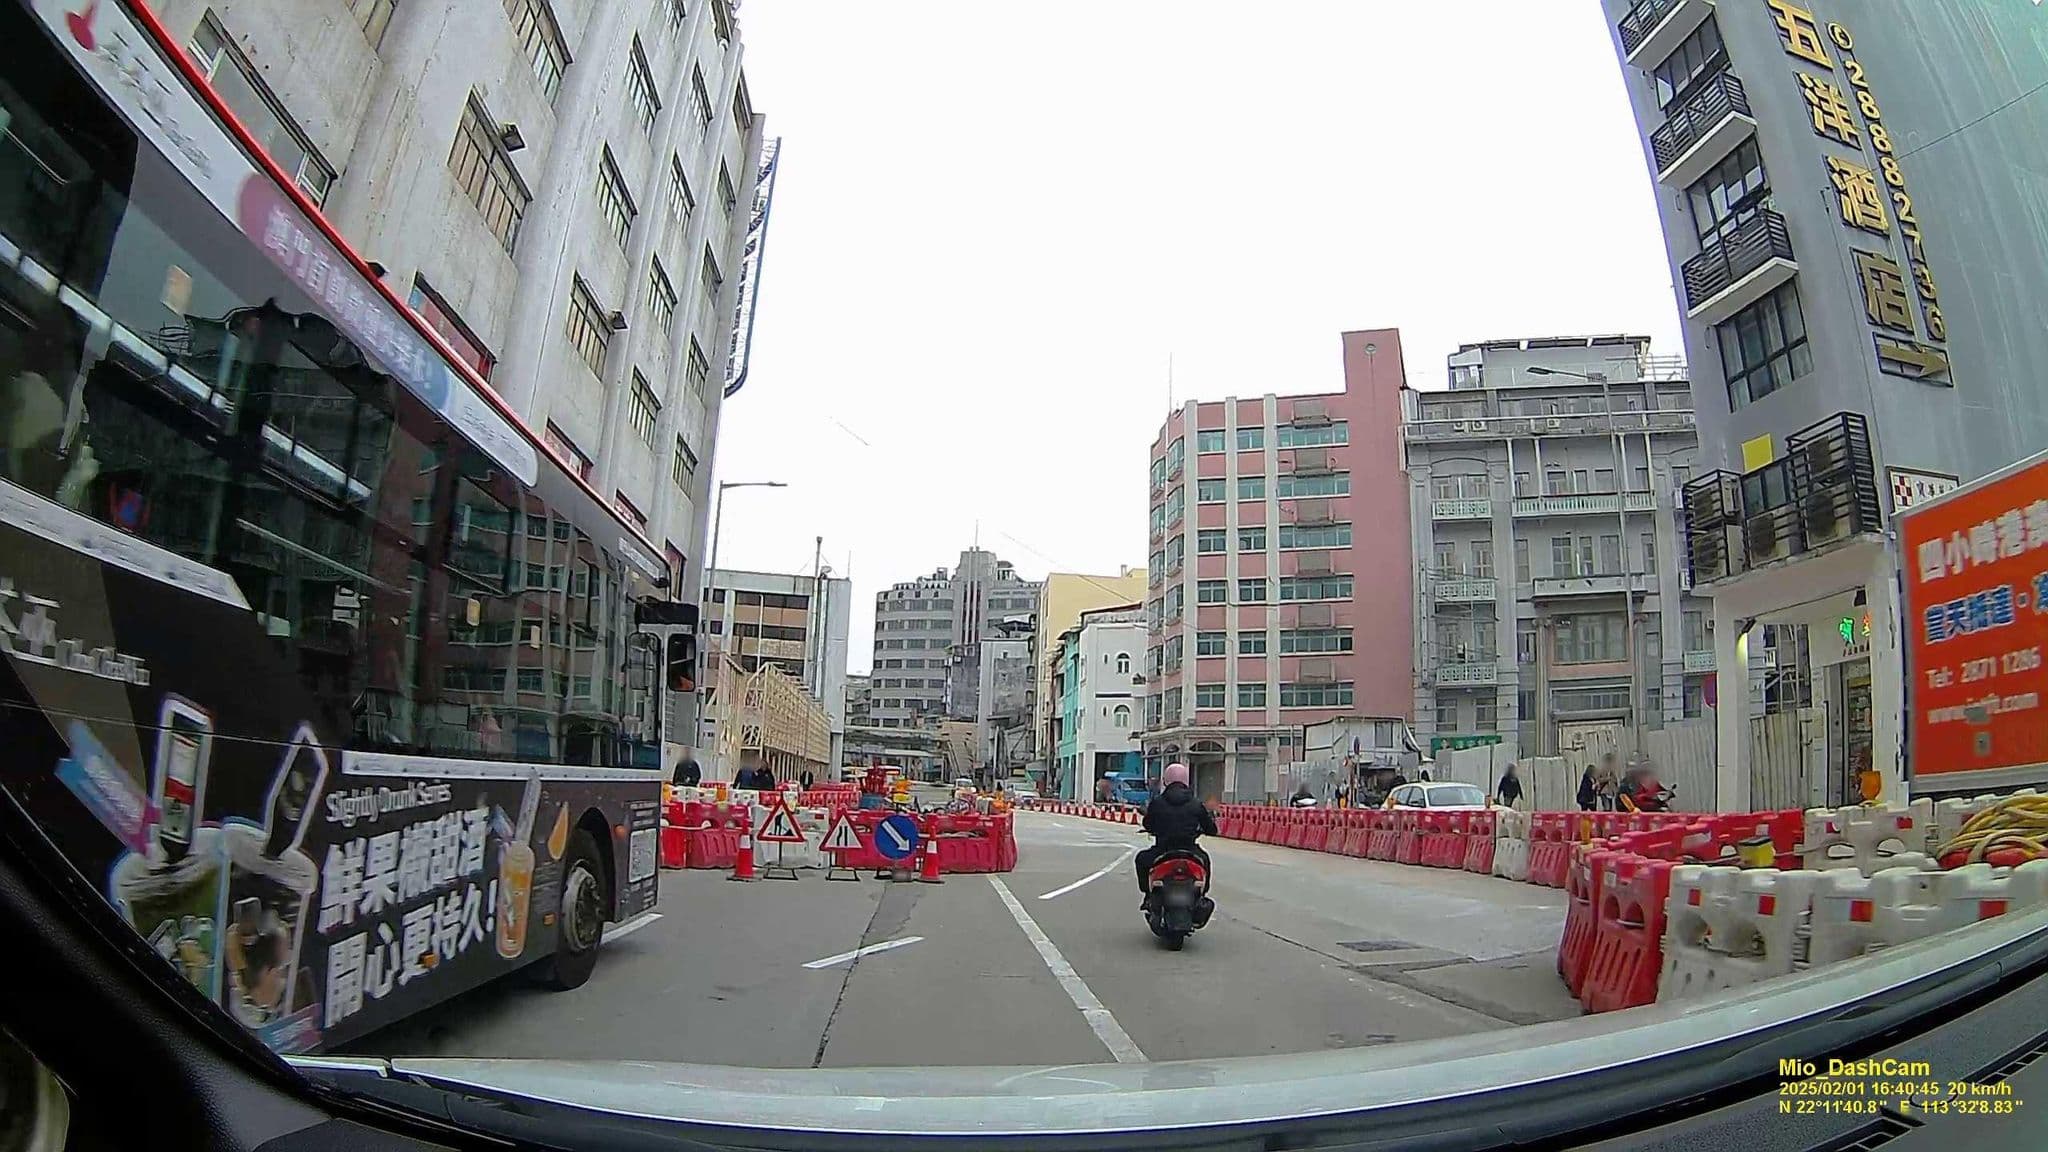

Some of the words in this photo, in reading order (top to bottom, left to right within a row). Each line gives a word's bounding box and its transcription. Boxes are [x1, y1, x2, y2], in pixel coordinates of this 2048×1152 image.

[1765, 0, 1914, 331] 五洋酒店
[1843, 60, 1946, 340] 28882736
